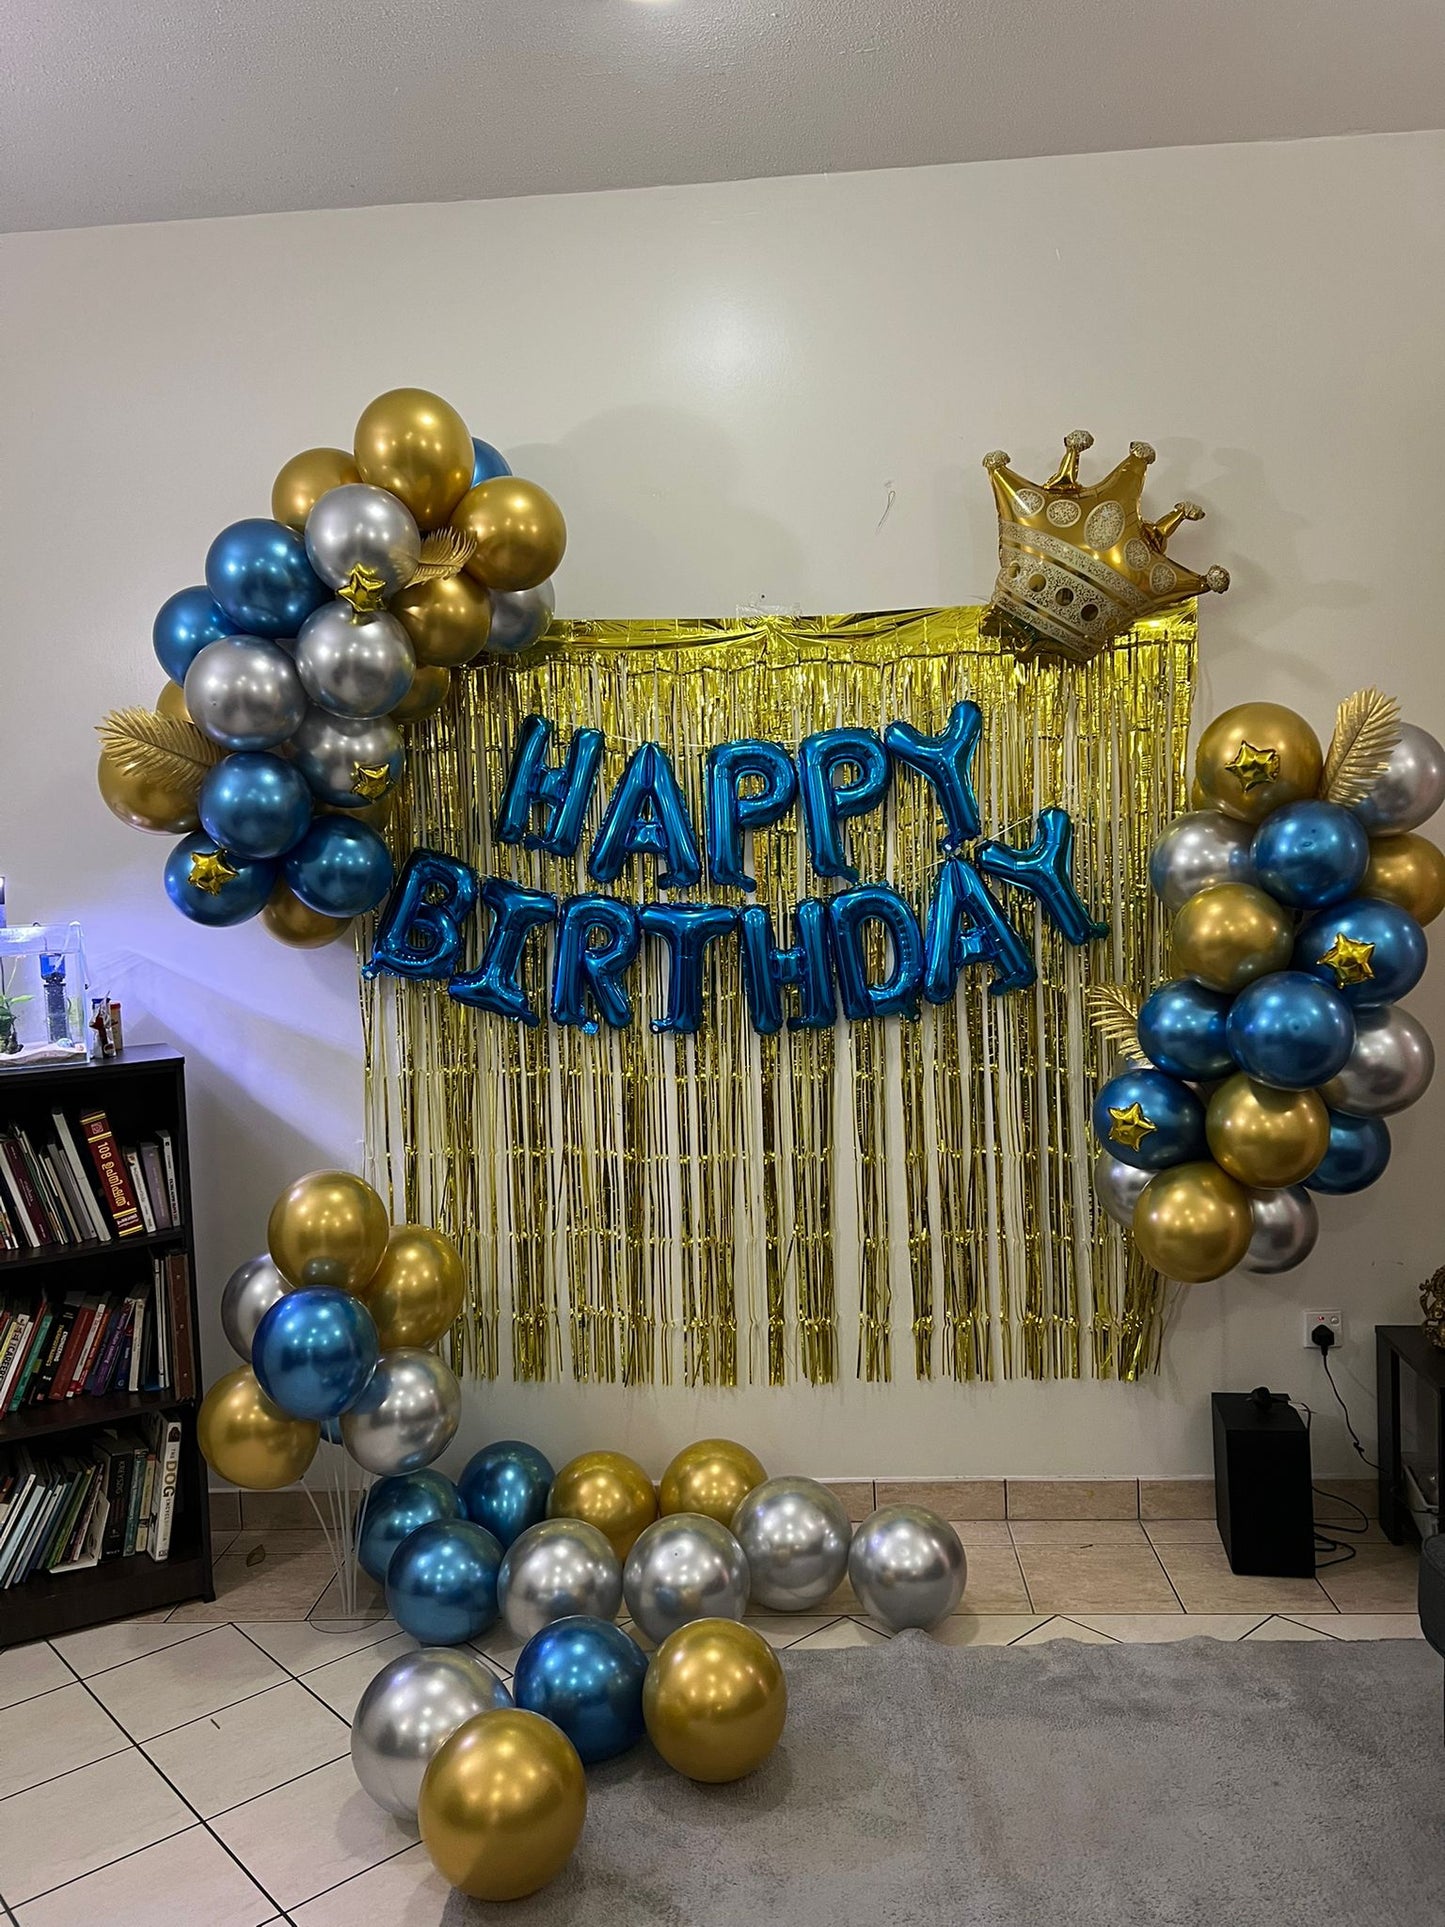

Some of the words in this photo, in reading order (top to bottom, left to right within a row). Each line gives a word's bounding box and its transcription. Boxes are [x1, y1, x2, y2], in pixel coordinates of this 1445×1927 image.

[496, 699, 983, 892] HAPPY
[362, 806, 1110, 1035] BIRTHDAY
[97, 1141, 112, 1159] 108
[162, 1460, 178, 1498] DOG
